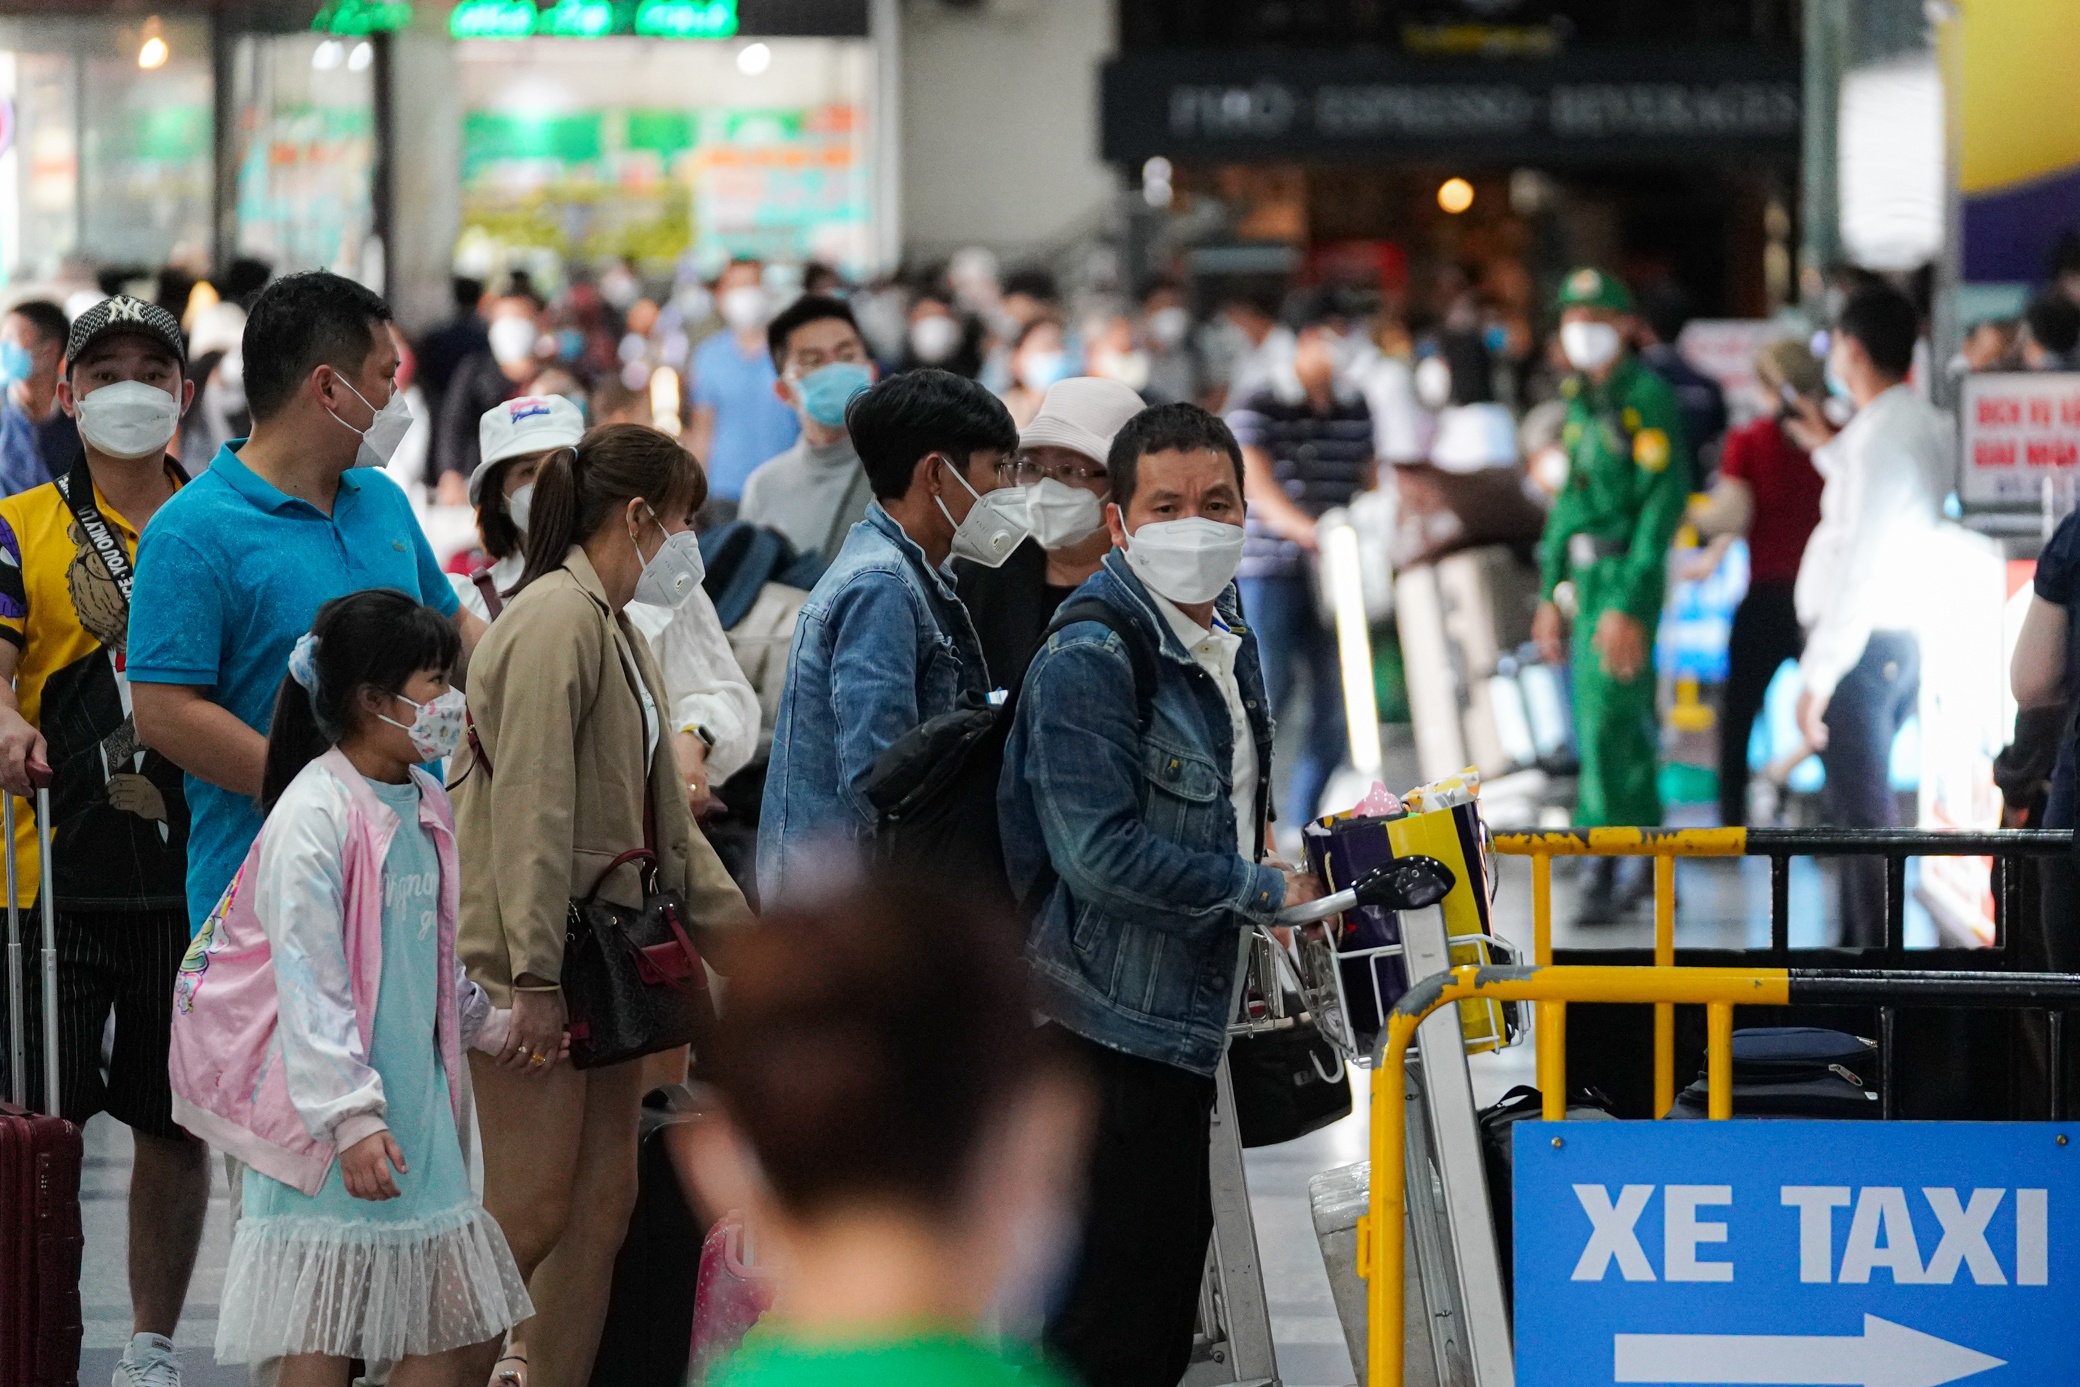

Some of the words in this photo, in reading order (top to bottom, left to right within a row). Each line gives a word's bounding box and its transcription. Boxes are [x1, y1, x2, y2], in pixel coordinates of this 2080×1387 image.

[107, 295, 144, 323] NY
[84, 521, 114, 550] ONLY
[101, 551, 129, 576] YOU
[1570, 1184, 1734, 1282] XE
[1780, 1186, 2048, 1286] TAXI
